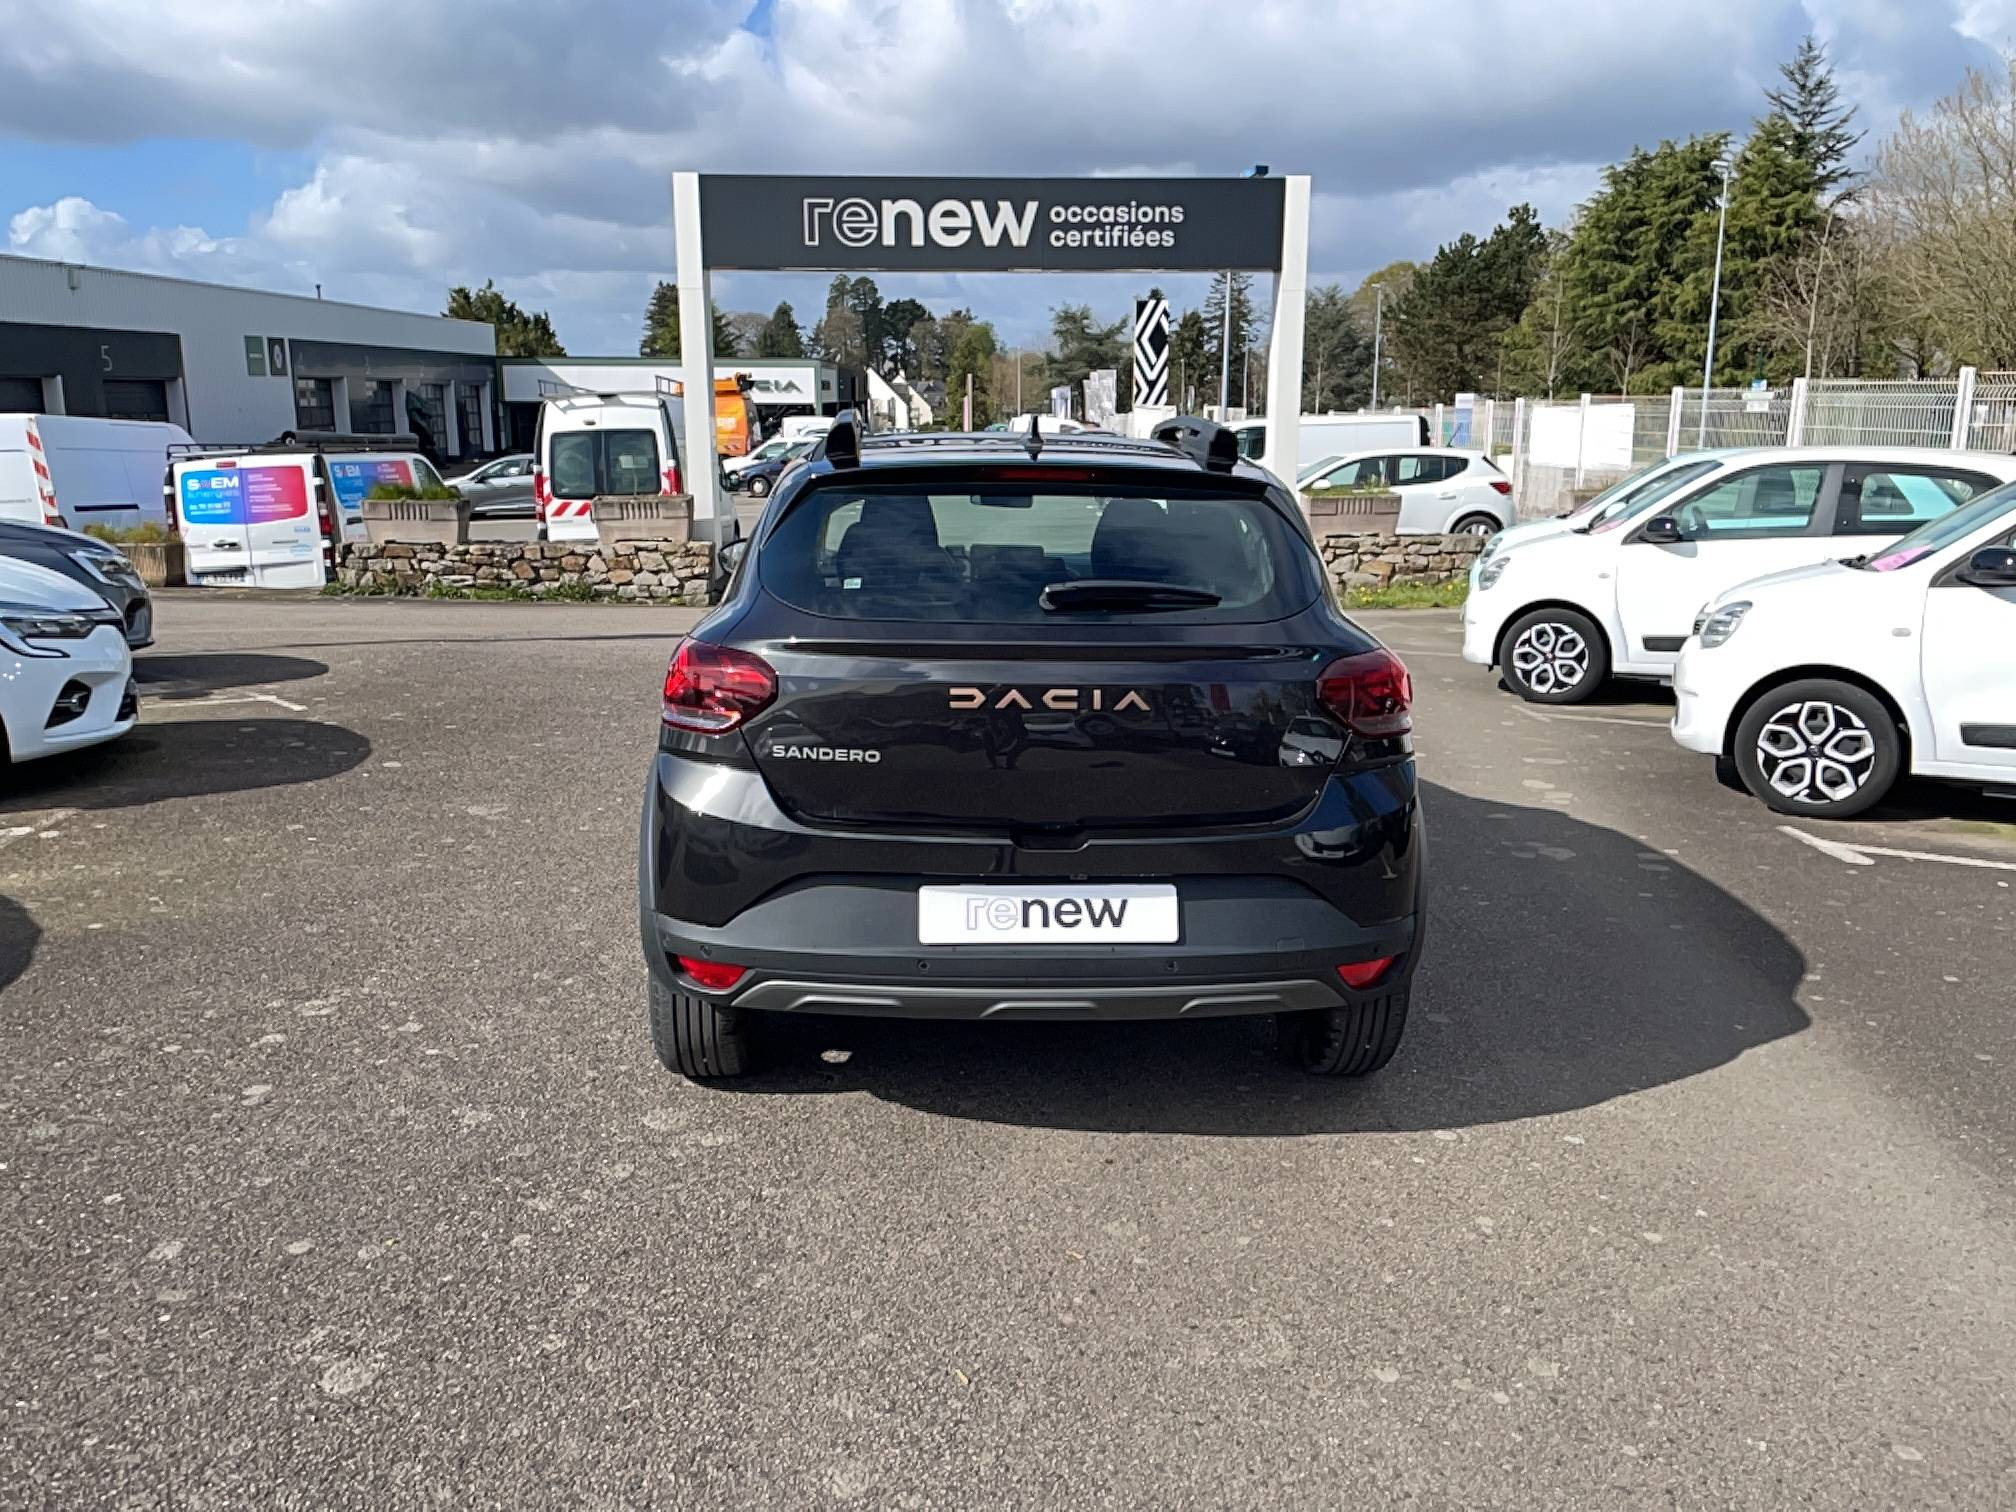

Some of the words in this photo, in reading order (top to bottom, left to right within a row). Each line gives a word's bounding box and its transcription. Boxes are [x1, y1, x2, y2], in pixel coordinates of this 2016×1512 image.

[803, 197, 1040, 247] renew
[1049, 201, 1185, 224] occasions
[1049, 225, 1175, 248] certifiées
[100, 345, 113, 372] 5
[753, 379, 803, 394] CIA
[948, 686, 1152, 712] DACIA
[771, 744, 882, 764] SANDERO
[966, 897, 1128, 931] renew
